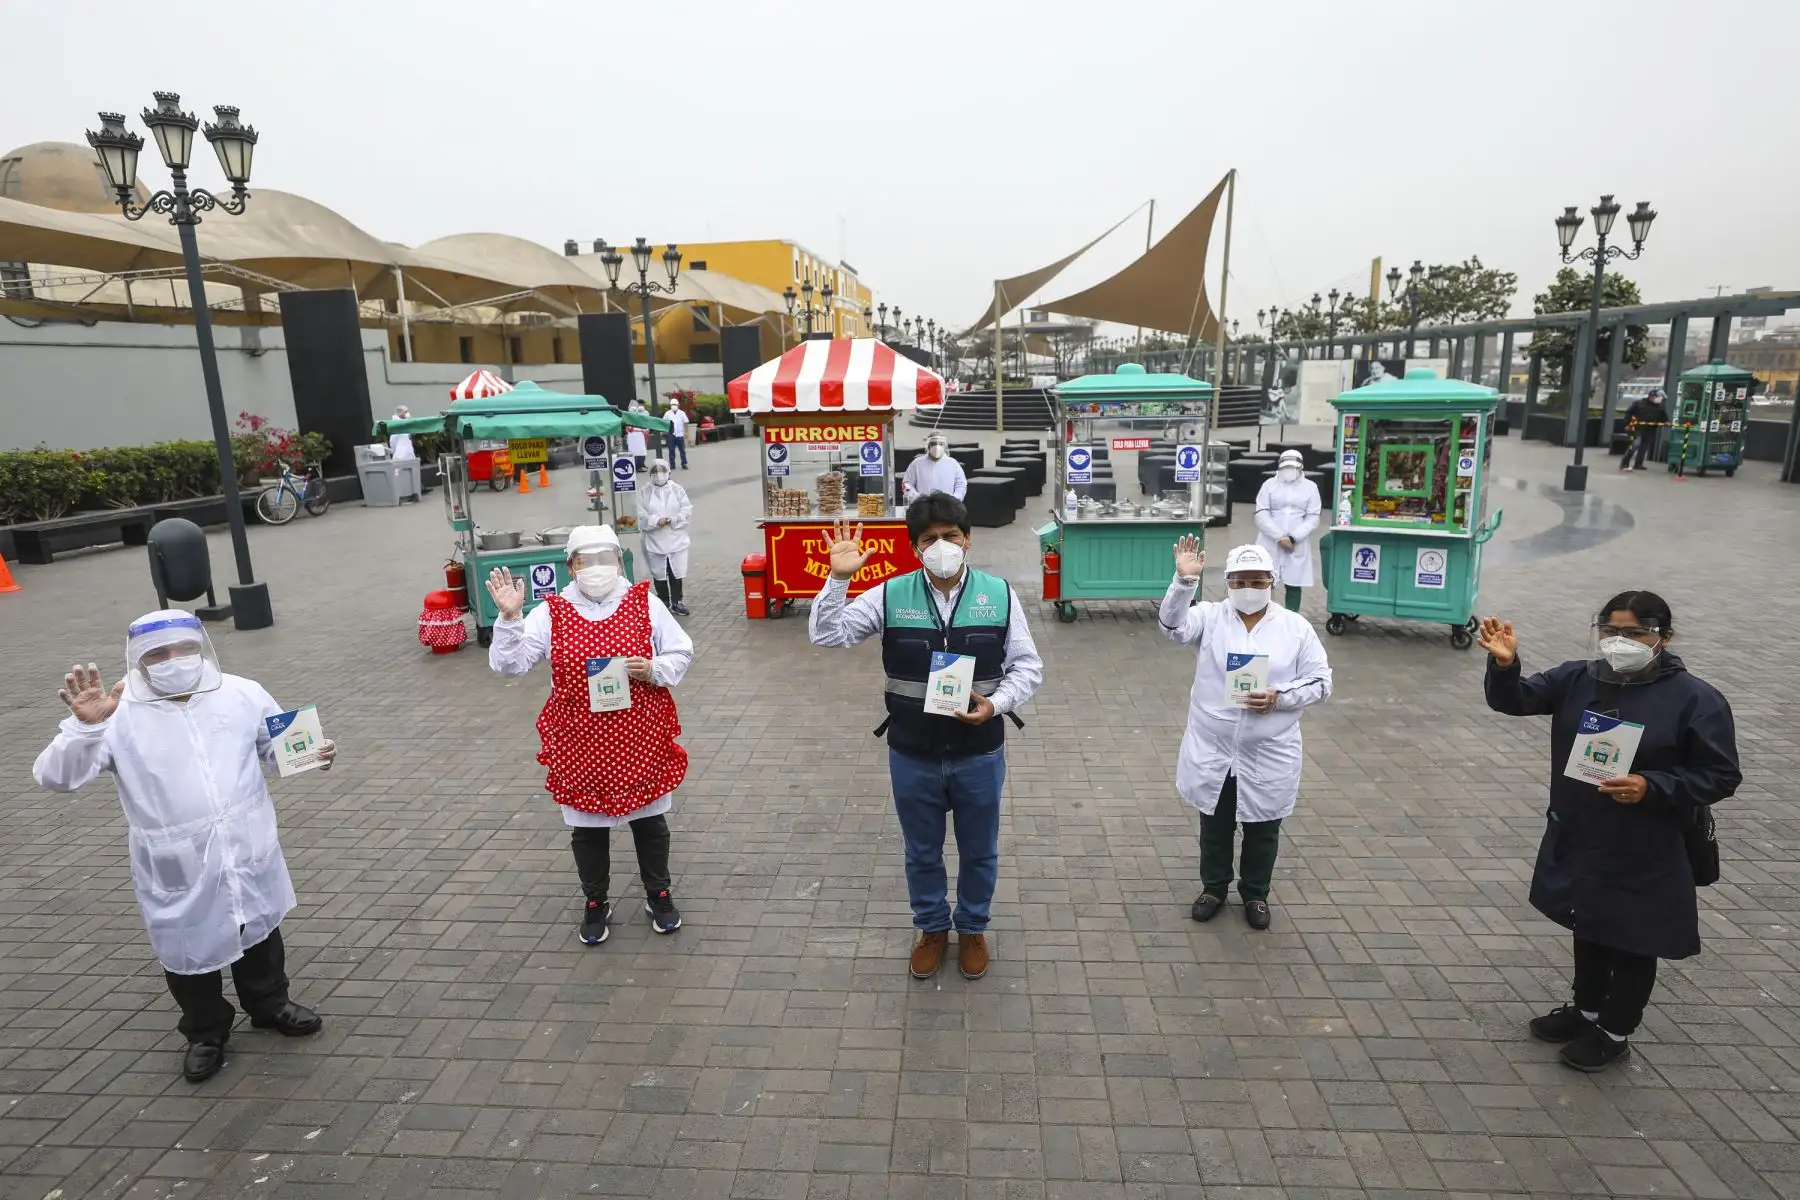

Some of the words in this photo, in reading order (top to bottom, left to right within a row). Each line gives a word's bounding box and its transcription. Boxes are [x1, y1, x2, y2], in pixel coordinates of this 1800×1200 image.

[766, 425, 879, 442] TURRONES
[511, 442, 527, 450] SOLO
[1113, 440, 1123, 449] SOLO
[1124, 440, 1134, 448] PARA
[1134, 439, 1149, 448] LLEVAR
[517, 450, 541, 459] LLEVAR
[803, 539, 895, 554] TURON
[803, 557, 898, 583] MEOCHA
[969, 610, 998, 619] LIMA
[1583, 722, 1600, 732] LIMA
